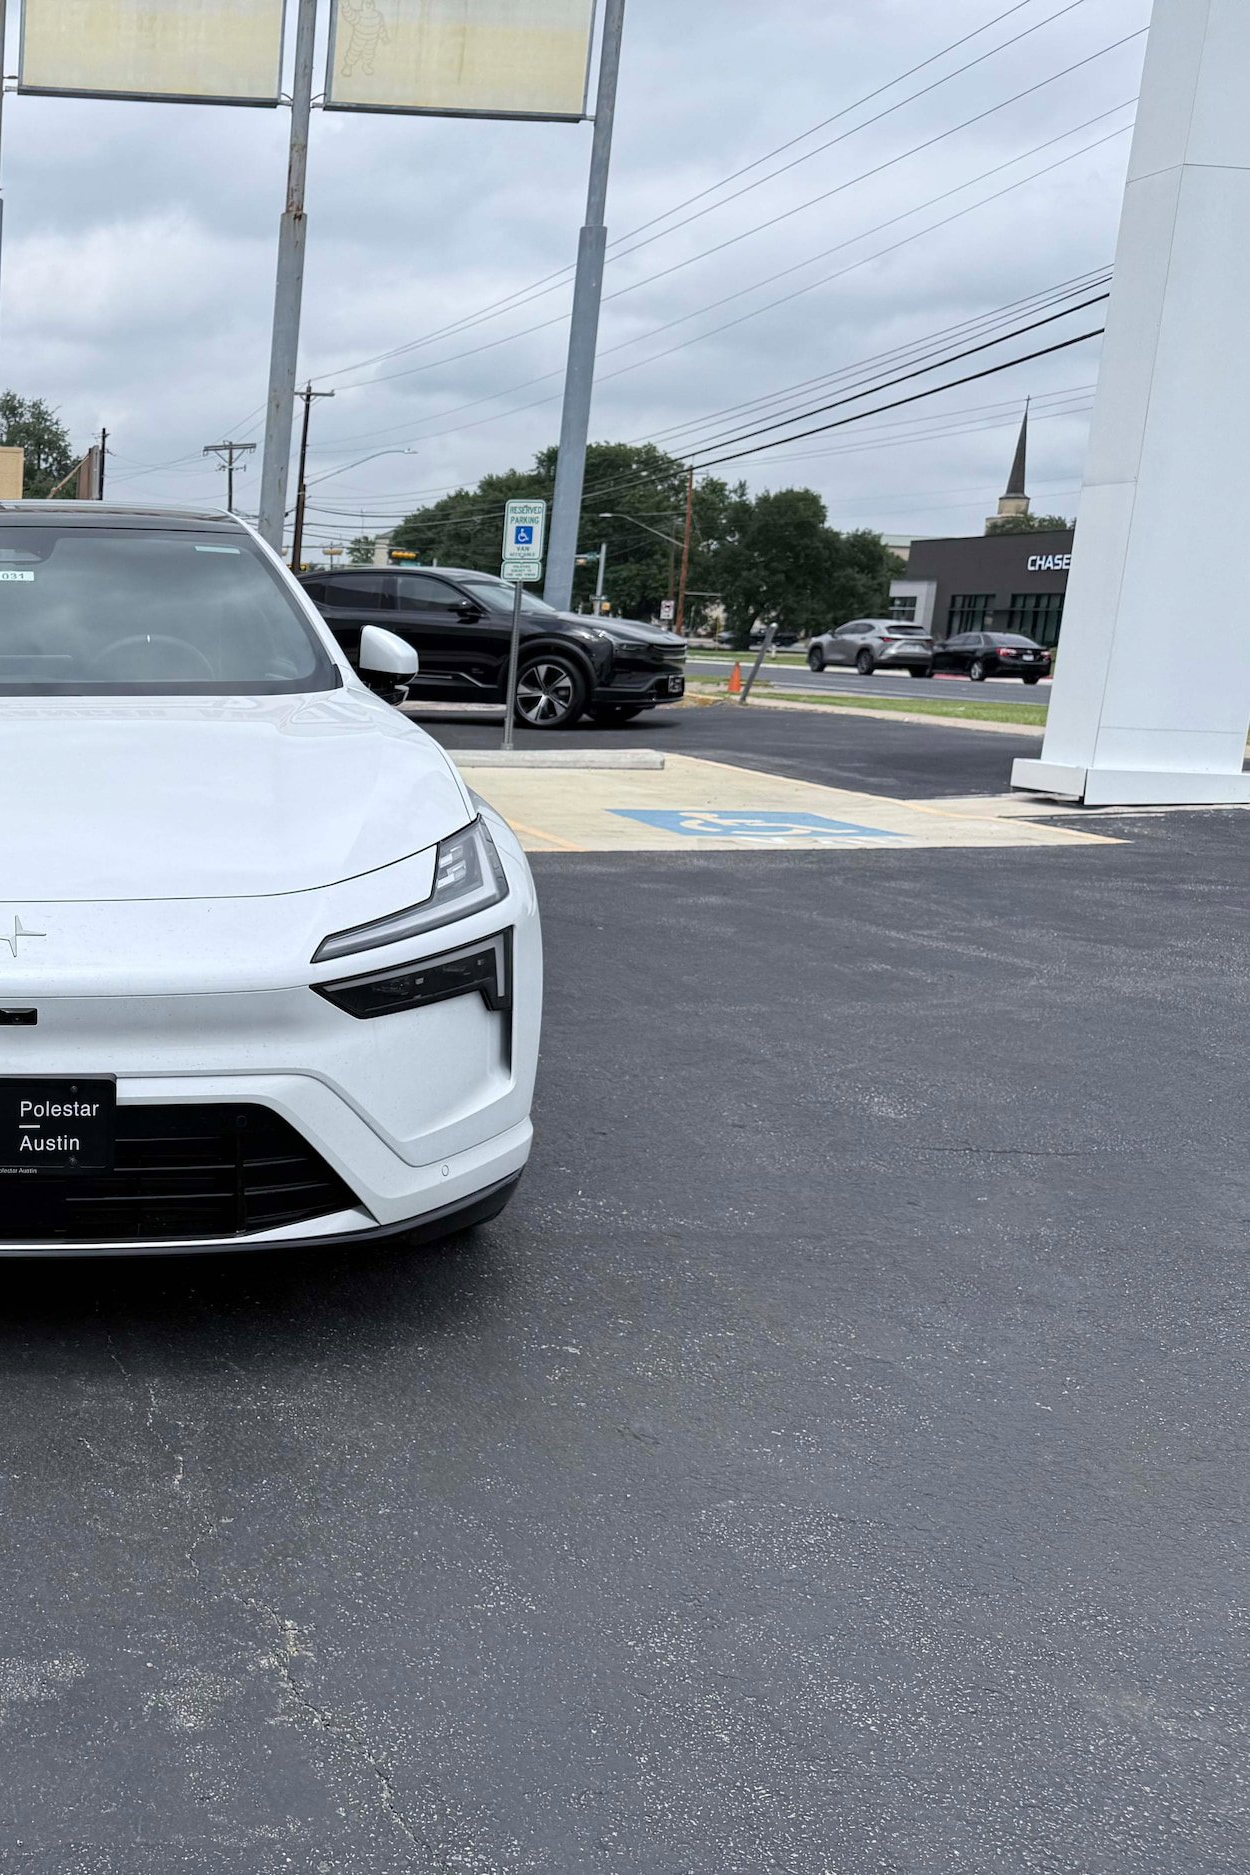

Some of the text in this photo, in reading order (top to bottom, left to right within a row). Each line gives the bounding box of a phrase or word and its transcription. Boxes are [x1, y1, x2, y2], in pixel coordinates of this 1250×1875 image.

[509, 506, 542, 514] RESERVED
[510, 516, 540, 524] PARKING
[1027, 554, 1071, 571] CHASE
[19, 1100, 100, 1118] Polestar
[19, 1134, 80, 1152] Austin
